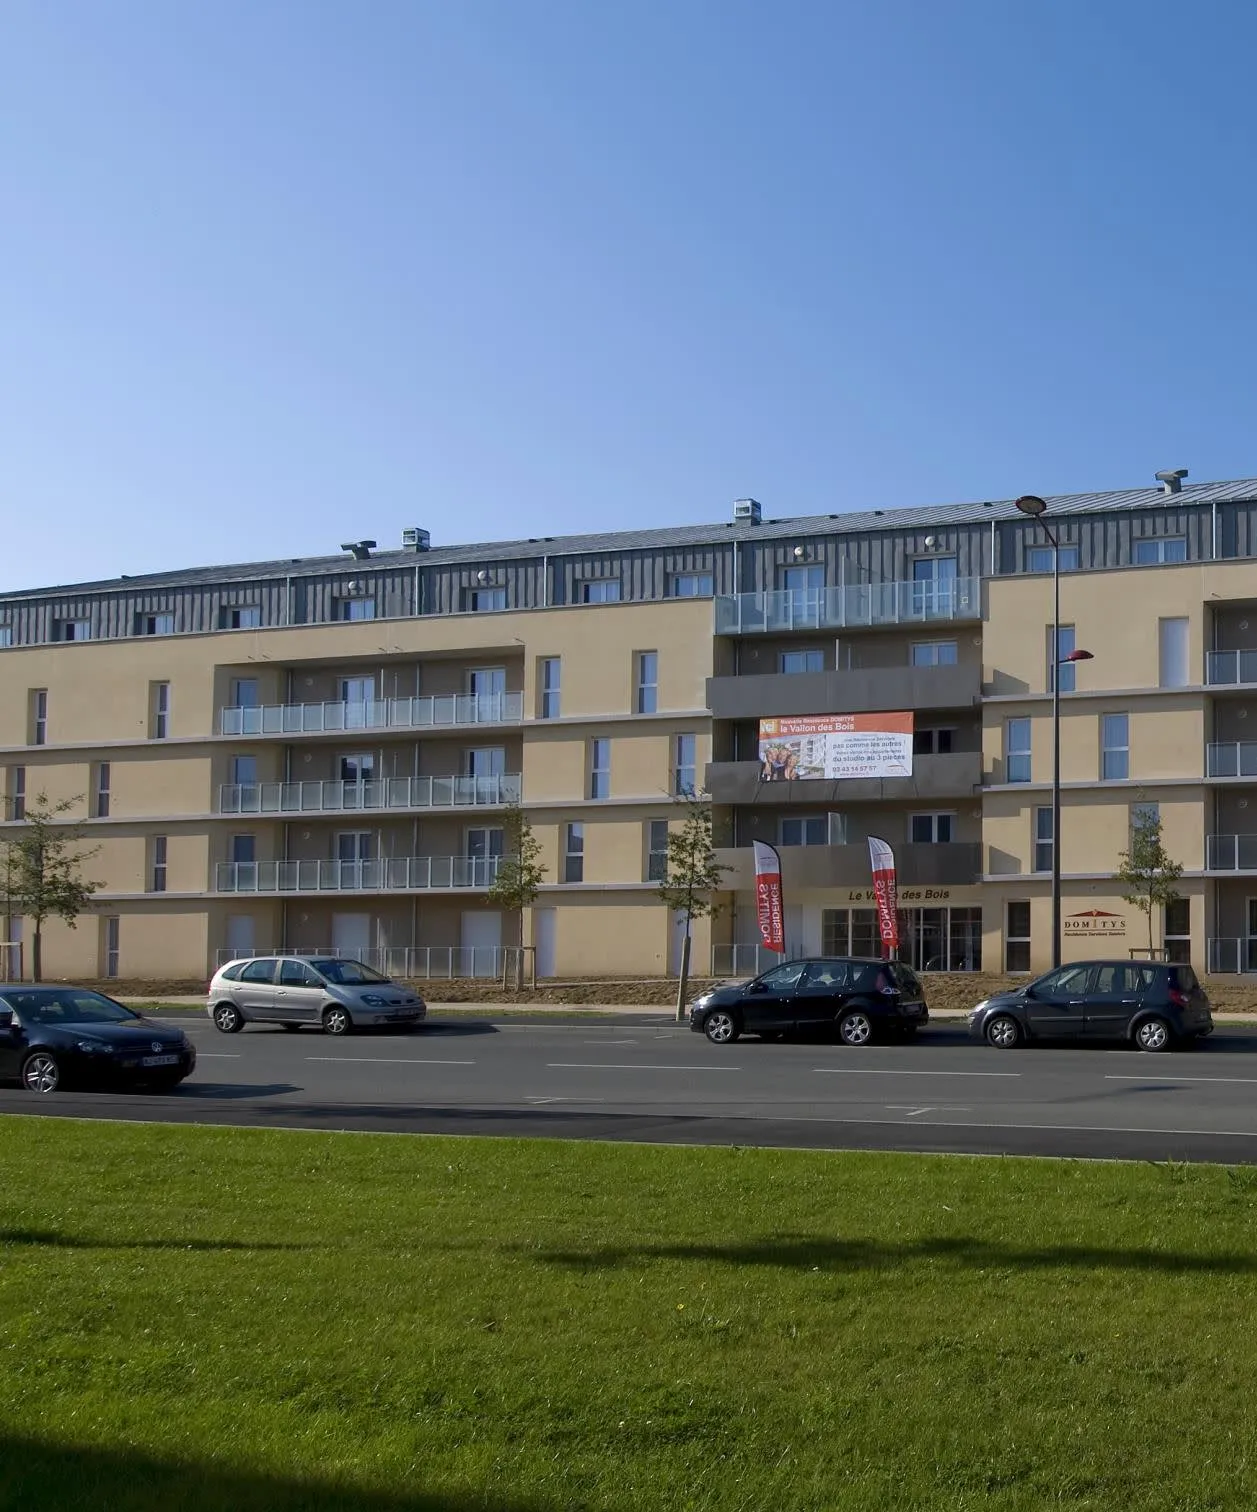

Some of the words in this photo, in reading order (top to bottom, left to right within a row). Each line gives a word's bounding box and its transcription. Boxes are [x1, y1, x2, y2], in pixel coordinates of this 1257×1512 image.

[780, 724, 789, 733] le
[790, 723, 818, 732] Vallon
[818, 723, 833, 731] des
[835, 721, 855, 731] Bois
[848, 891, 862, 900] Le
[901, 890, 921, 900] des
[924, 889, 950, 899] Bois
[1064, 919, 1126, 928] DOMITYS
